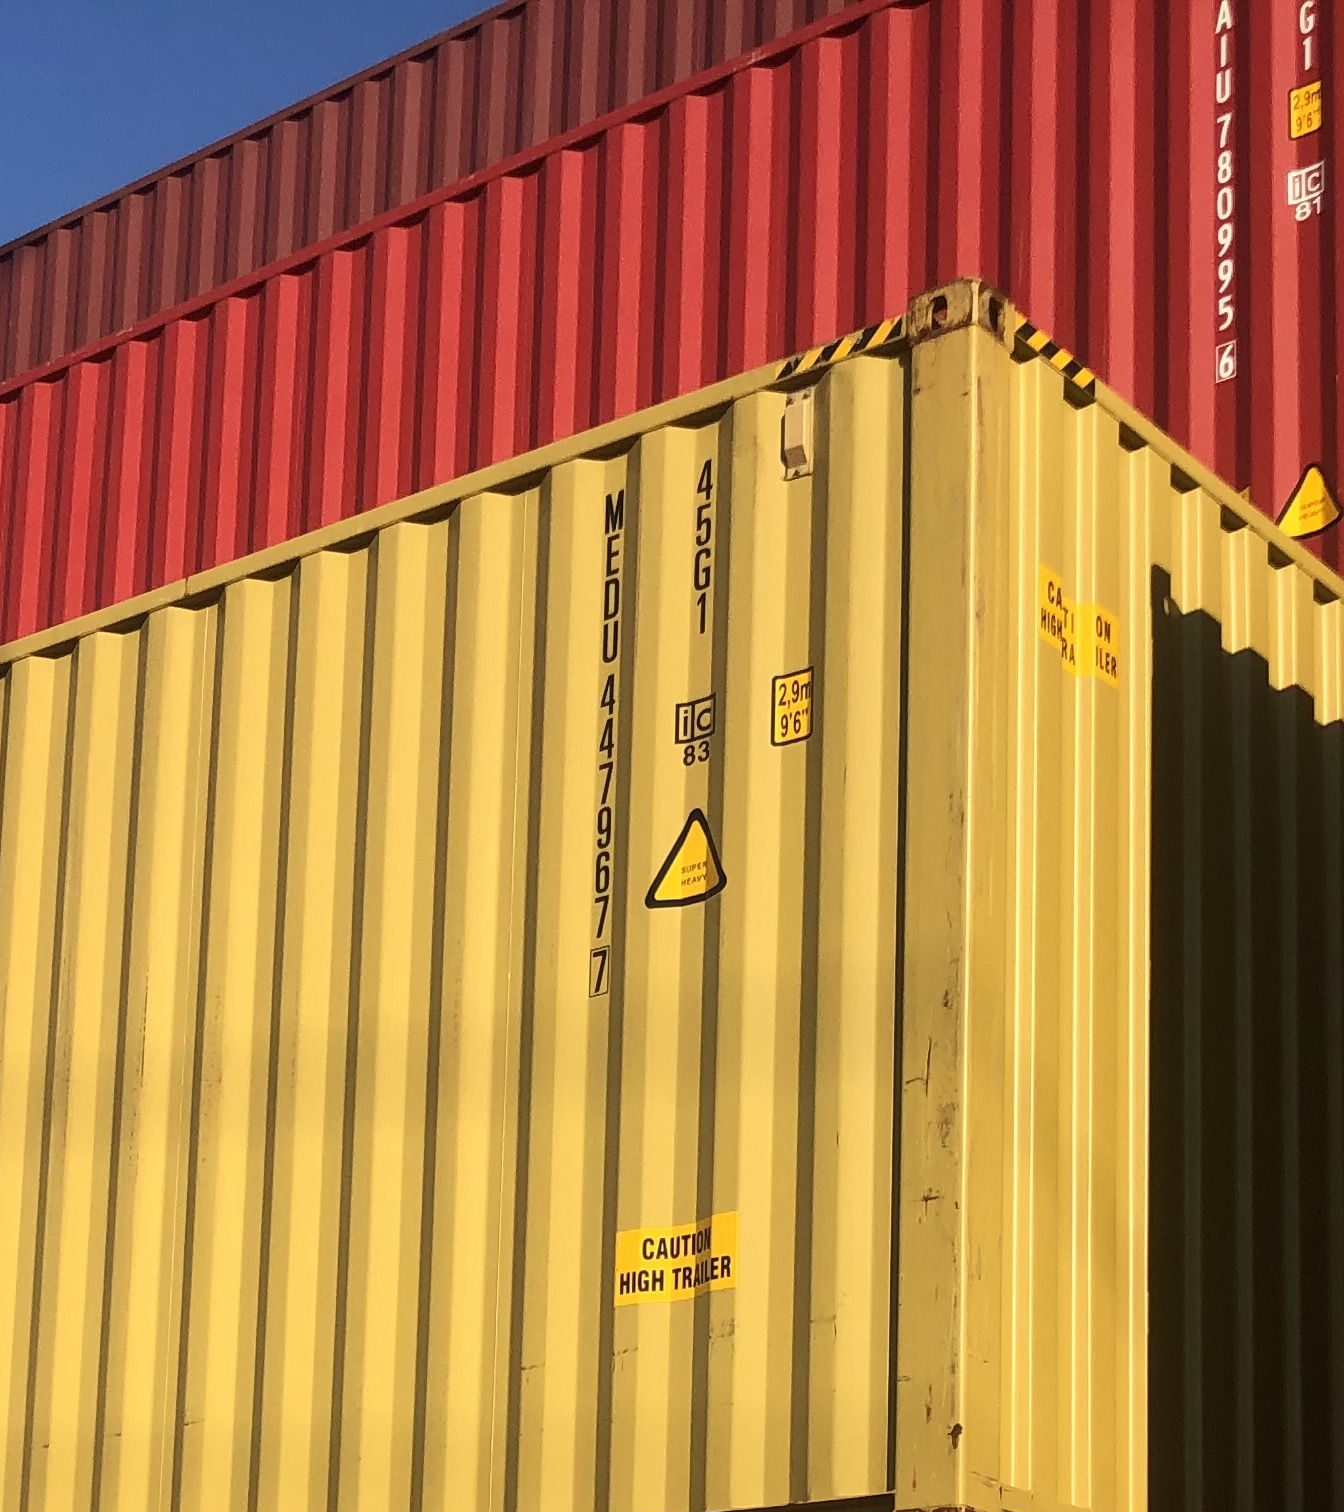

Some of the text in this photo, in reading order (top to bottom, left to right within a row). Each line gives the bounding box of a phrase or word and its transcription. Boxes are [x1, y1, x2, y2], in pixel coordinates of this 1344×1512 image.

[1215, 0, 1233, 105] AIU
[1300, 0, 1315, 71] G1
[1216, 112, 1235, 332] 780995
[1295, 197, 1322, 222] 81
[601, 489, 625, 664] MEDU
[693, 458, 713, 635] 45G1
[682, 740, 711, 767] 83
[594, 673, 616, 939] 447967
[619, 1255, 732, 1296] HIGH TRAILER
[641, 1226, 712, 1261] CAUTION
